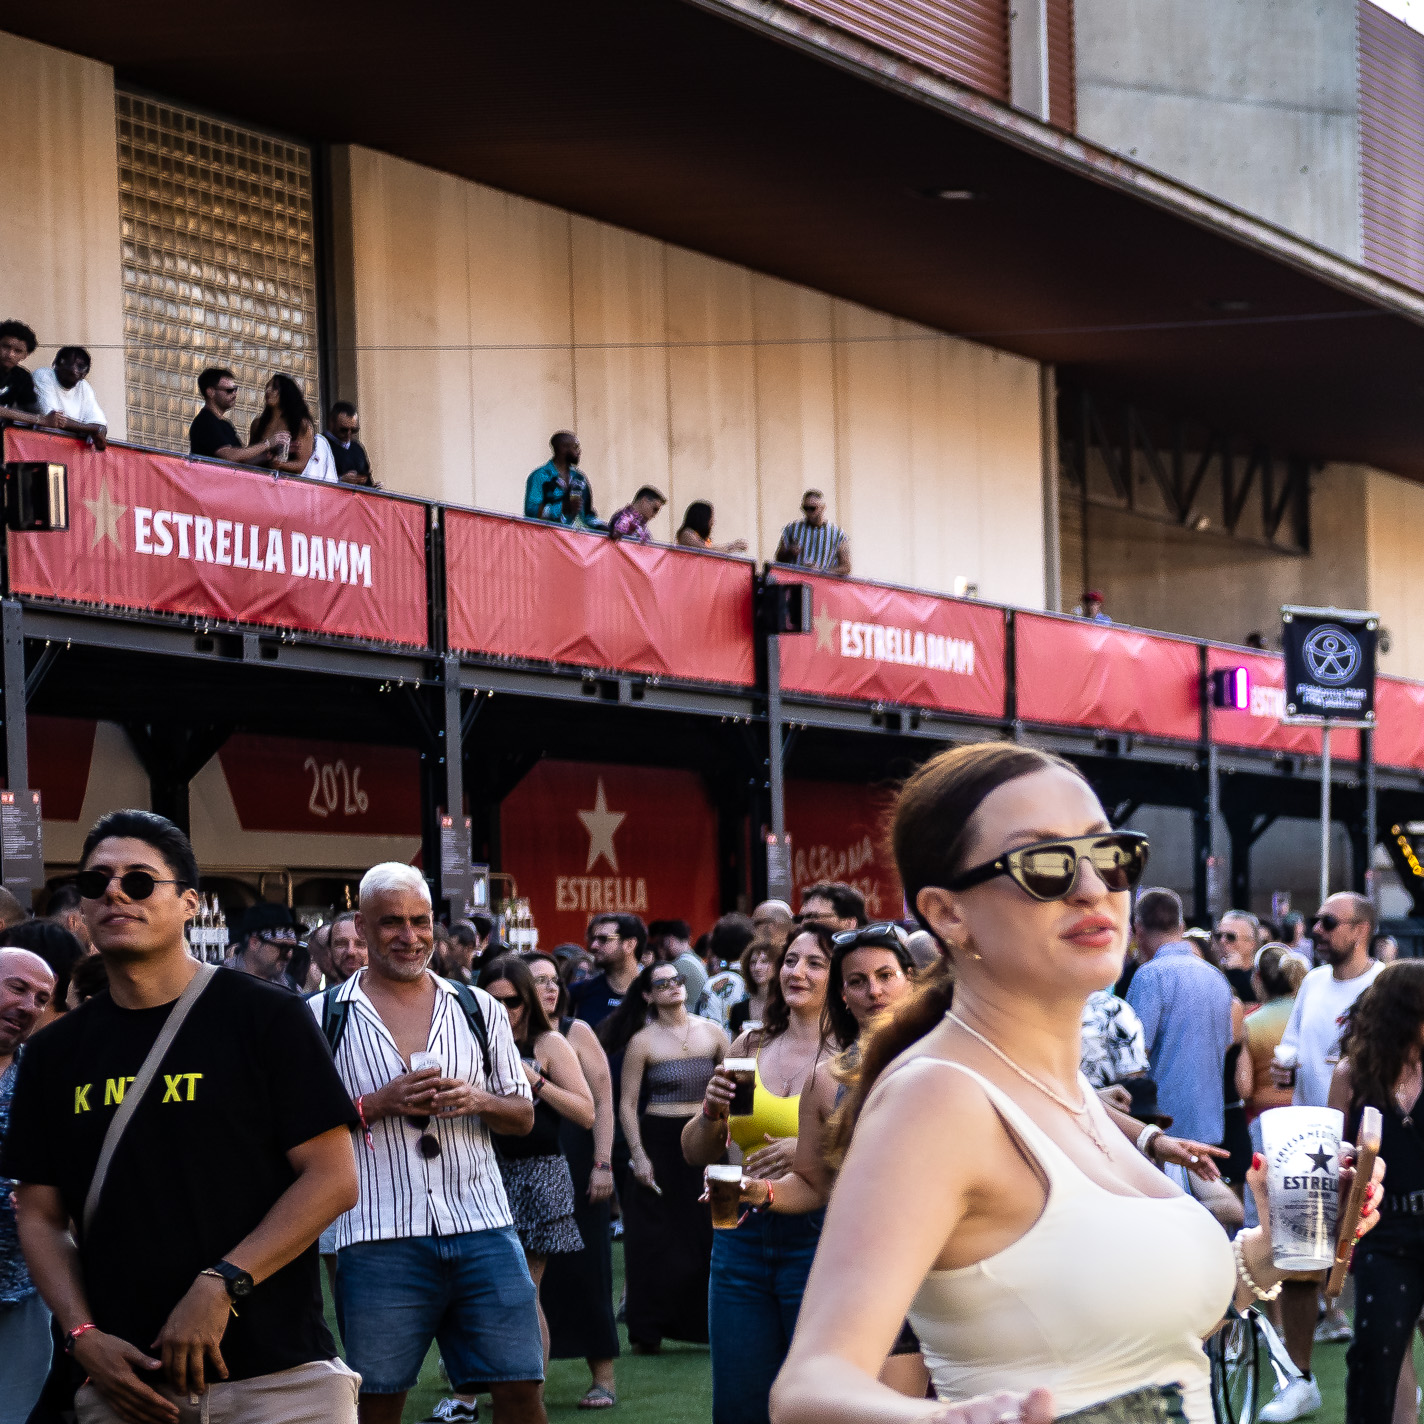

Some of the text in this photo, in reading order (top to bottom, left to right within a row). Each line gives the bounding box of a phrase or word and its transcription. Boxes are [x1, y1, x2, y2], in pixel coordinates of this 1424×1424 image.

[134, 506, 373, 588] ESTRELLA DAMM
[840, 619, 926, 667] ESTRELLA
[303, 755, 369, 817] 2026
[555, 875, 649, 912] ESTRELLA
